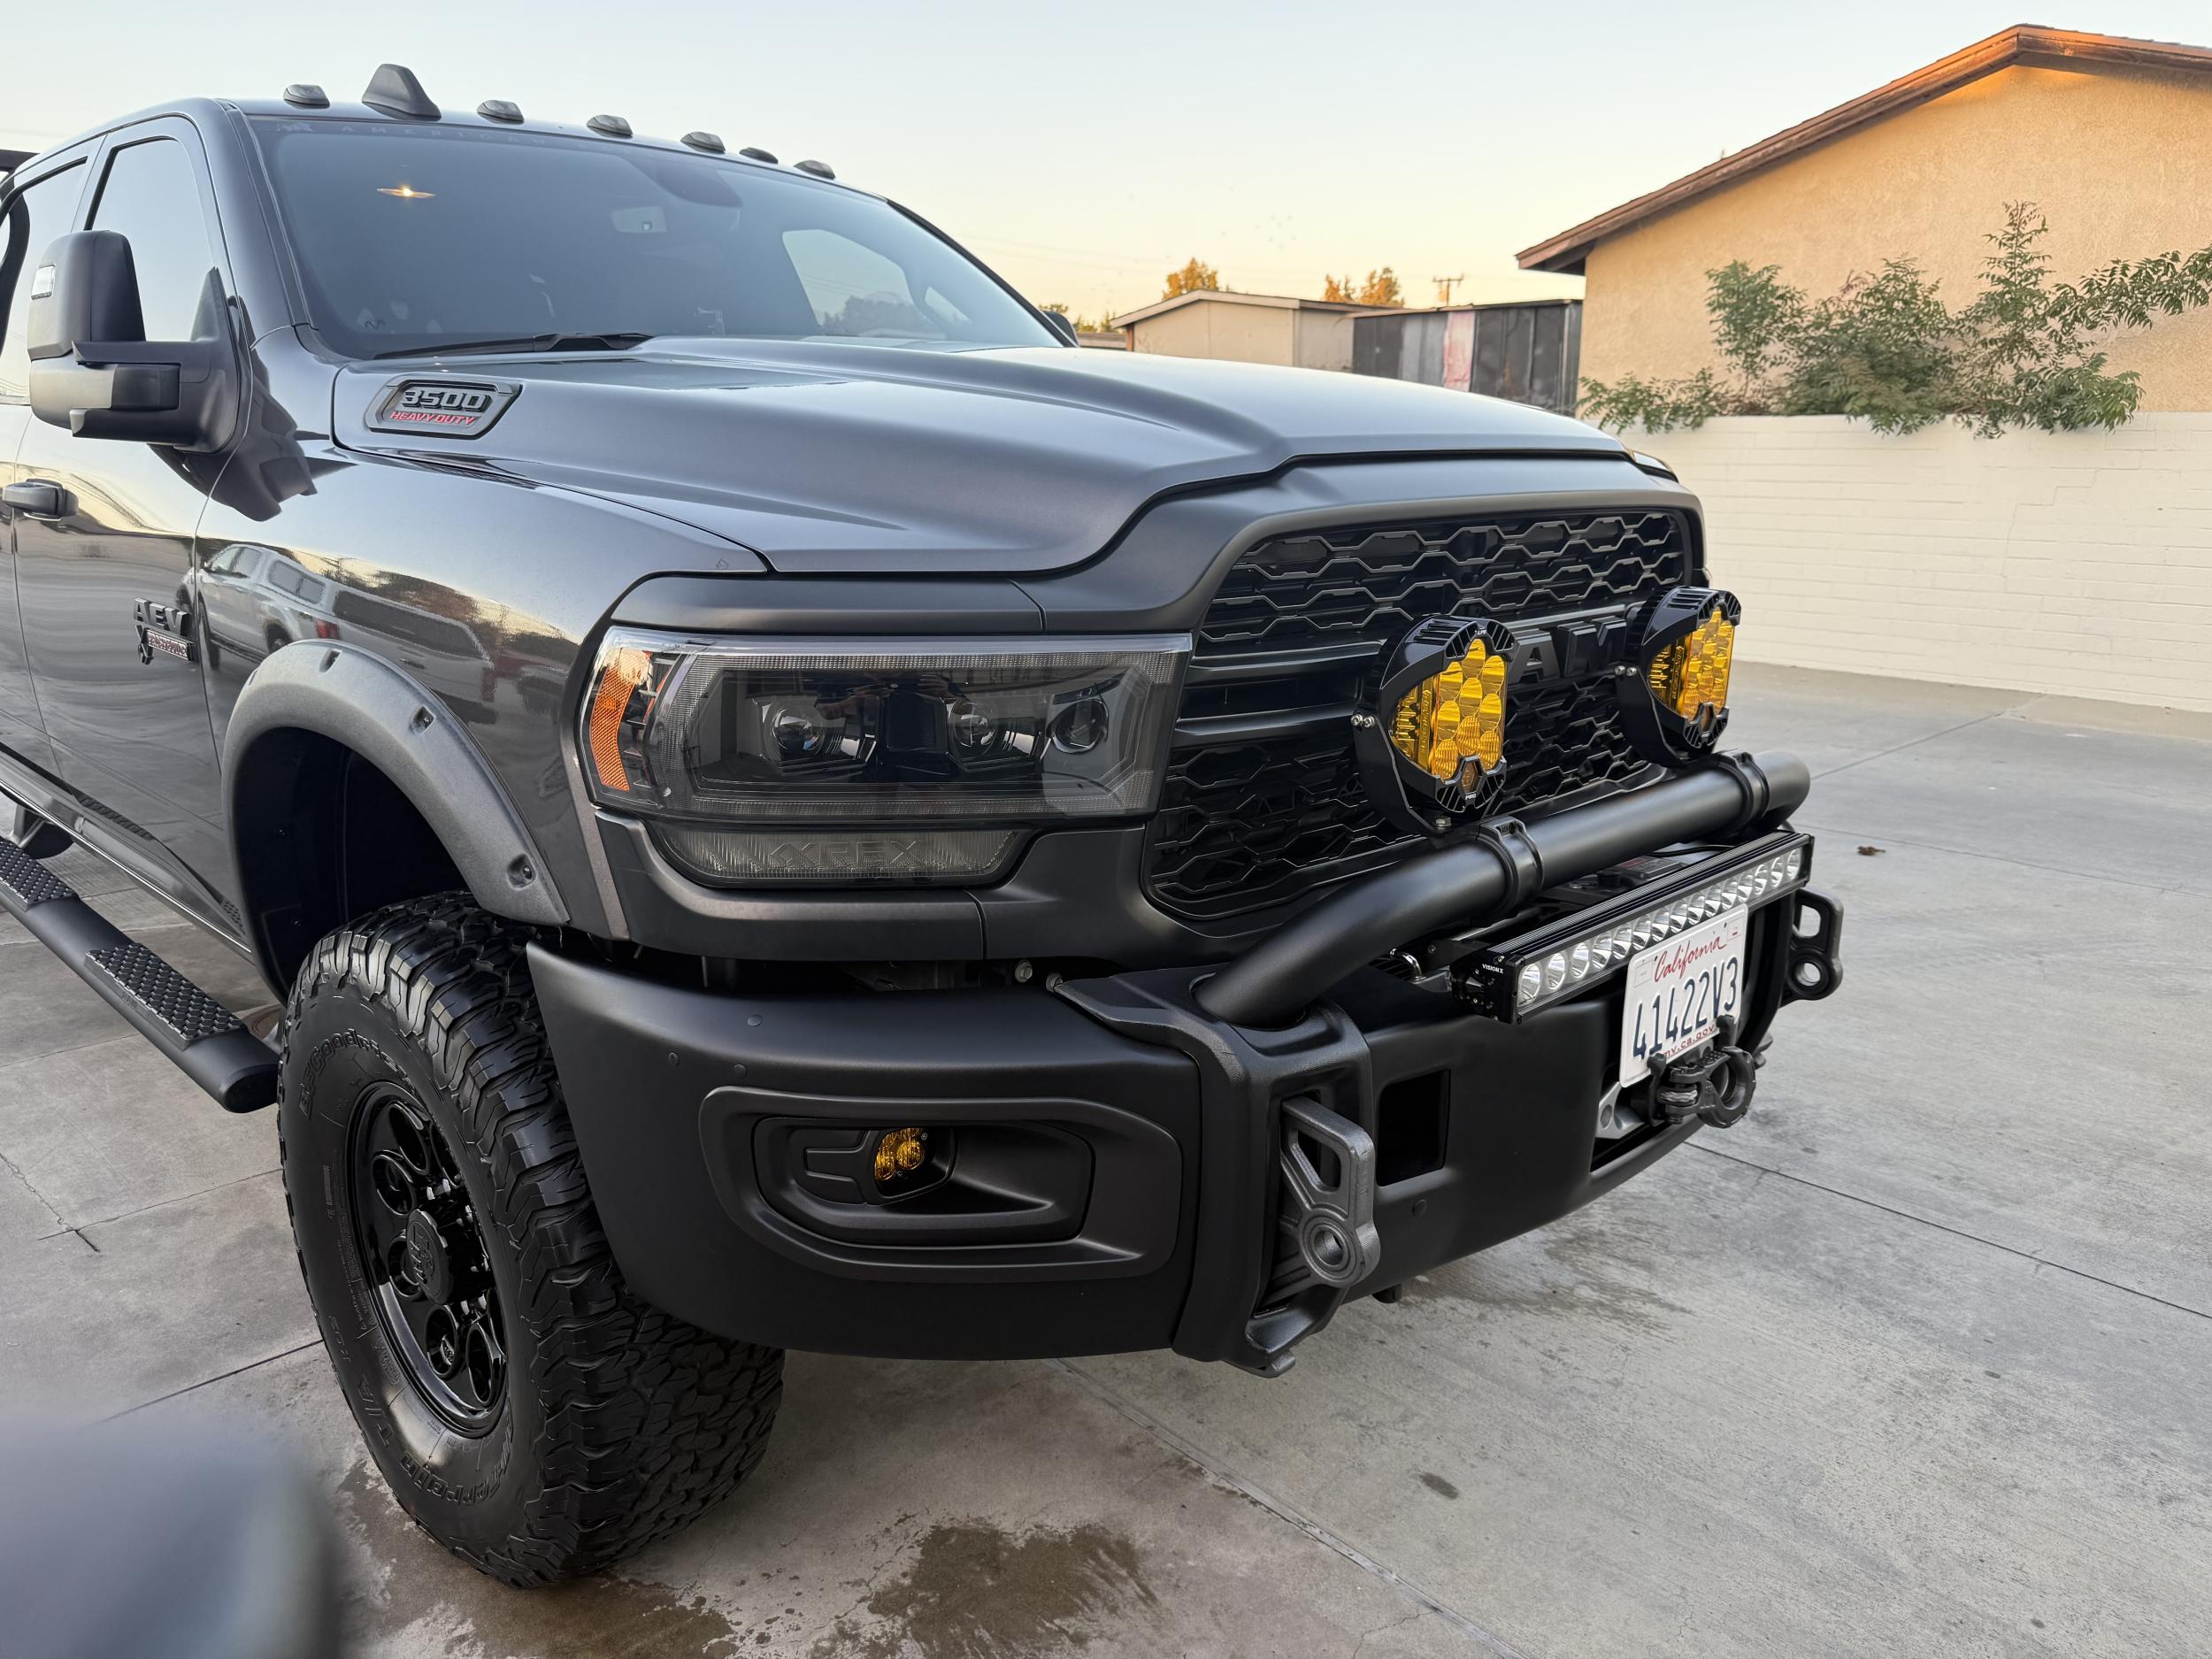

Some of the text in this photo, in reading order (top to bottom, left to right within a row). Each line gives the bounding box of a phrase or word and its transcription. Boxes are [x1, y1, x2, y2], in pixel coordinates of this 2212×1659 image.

[389, 411, 479, 426] HEAVY DUTY
[401, 389, 492, 412] 3500
[134, 598, 188, 636] AEV
[1508, 617, 1627, 684] AM
[1655, 936, 1727, 982] California
[1632, 956, 1738, 1060] 41422V3
[1663, 1025, 1715, 1057] mv.ca.gov
